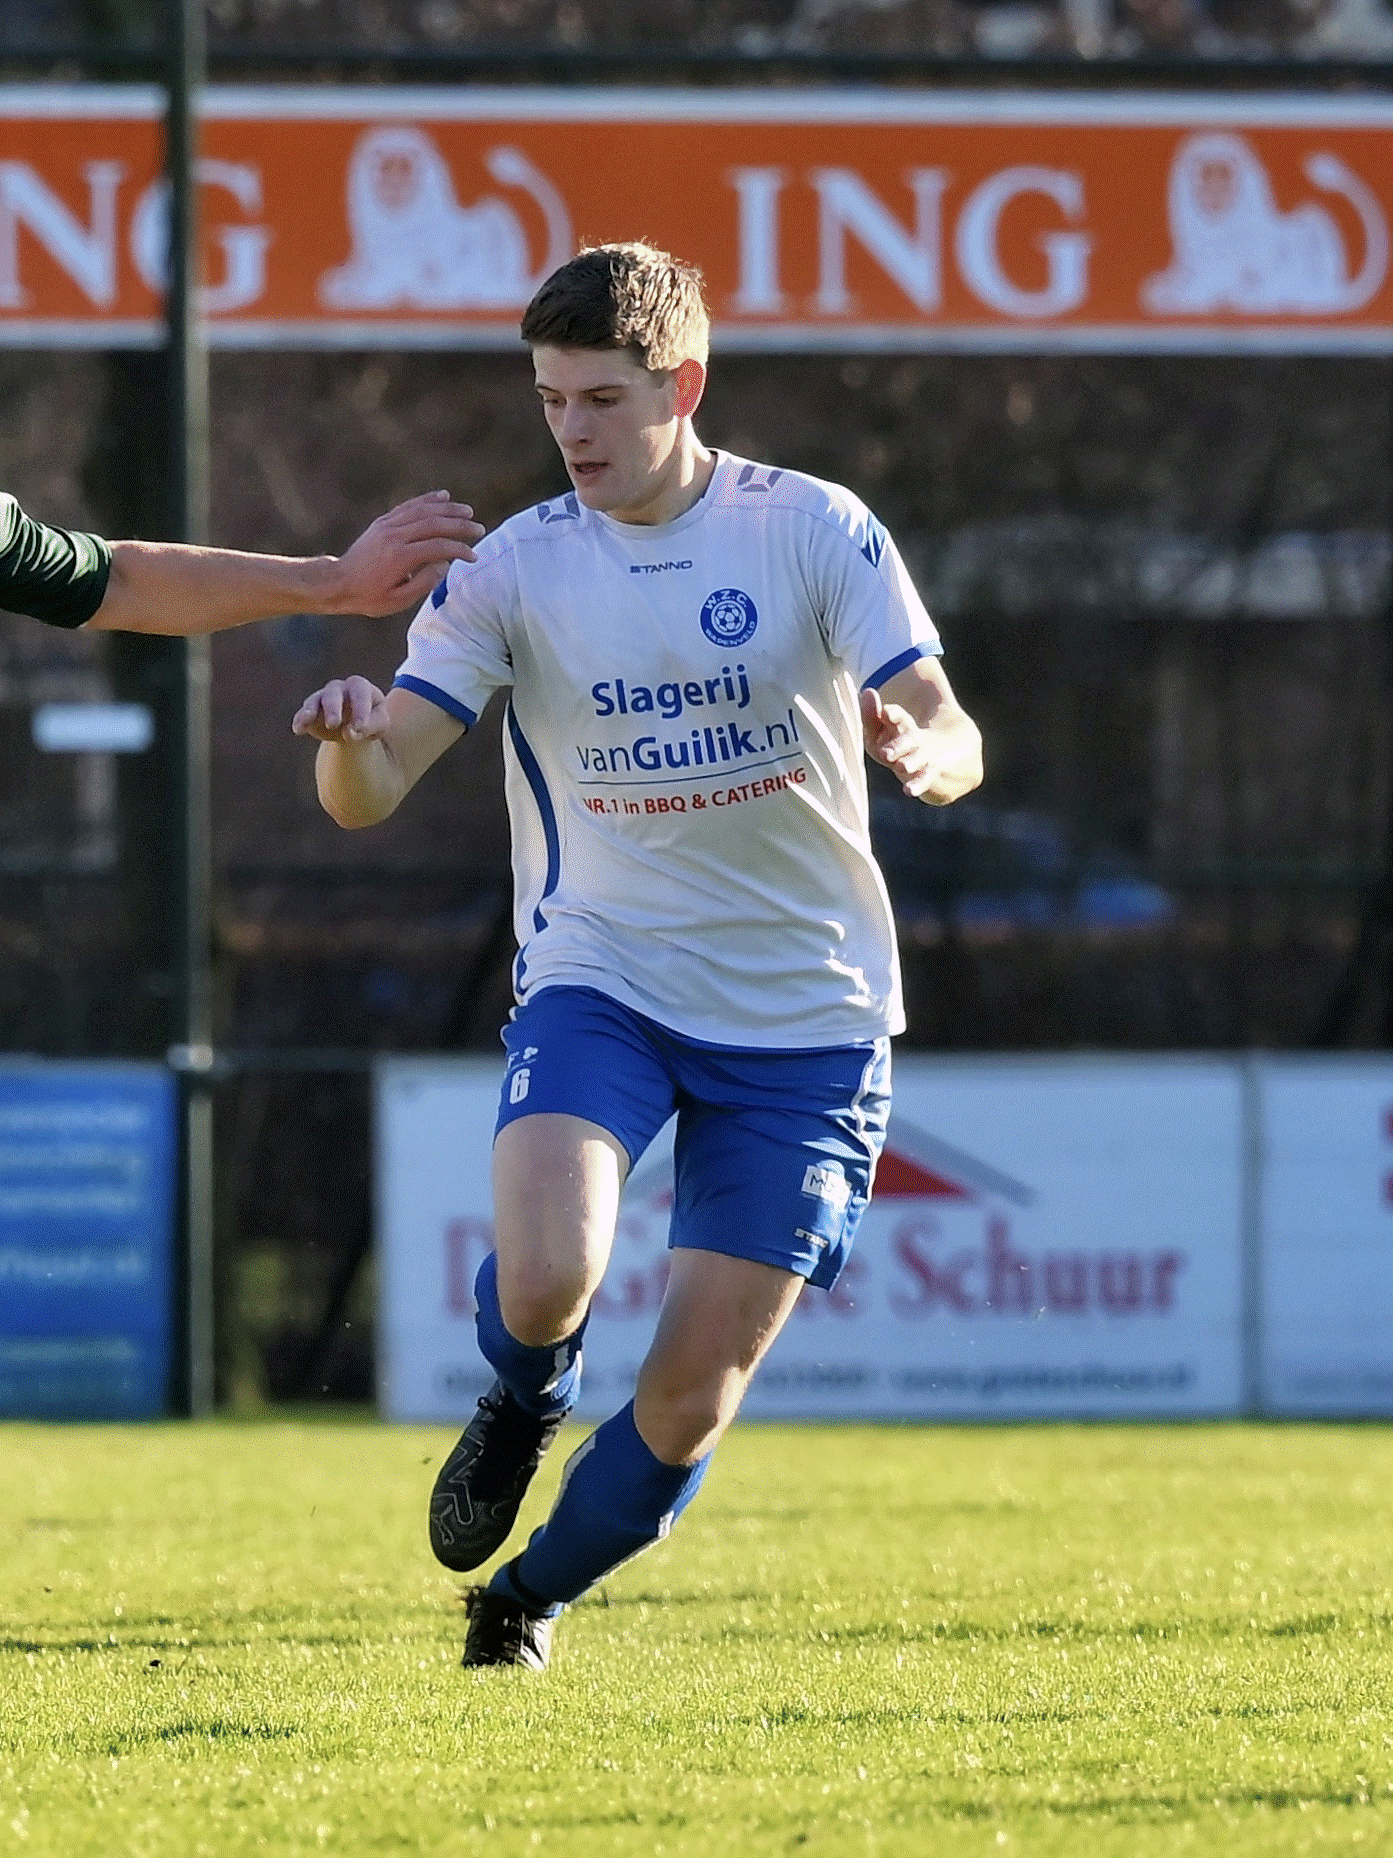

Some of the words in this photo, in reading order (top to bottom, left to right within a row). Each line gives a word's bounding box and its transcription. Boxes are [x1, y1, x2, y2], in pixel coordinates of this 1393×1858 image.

[726, 165, 1092, 318] ING
[630, 560, 693, 574] STANNO
[592, 664, 751, 719] Slagerij
[577, 709, 799, 772] vanGuilik.nl
[623, 798, 640, 815] in
[644, 796, 687, 815] BBQ
[691, 793, 708, 810] &
[711, 767, 807, 808] CATERING
[509, 1068, 531, 1105] 6
[889, 1211, 1184, 1318] Schuur
